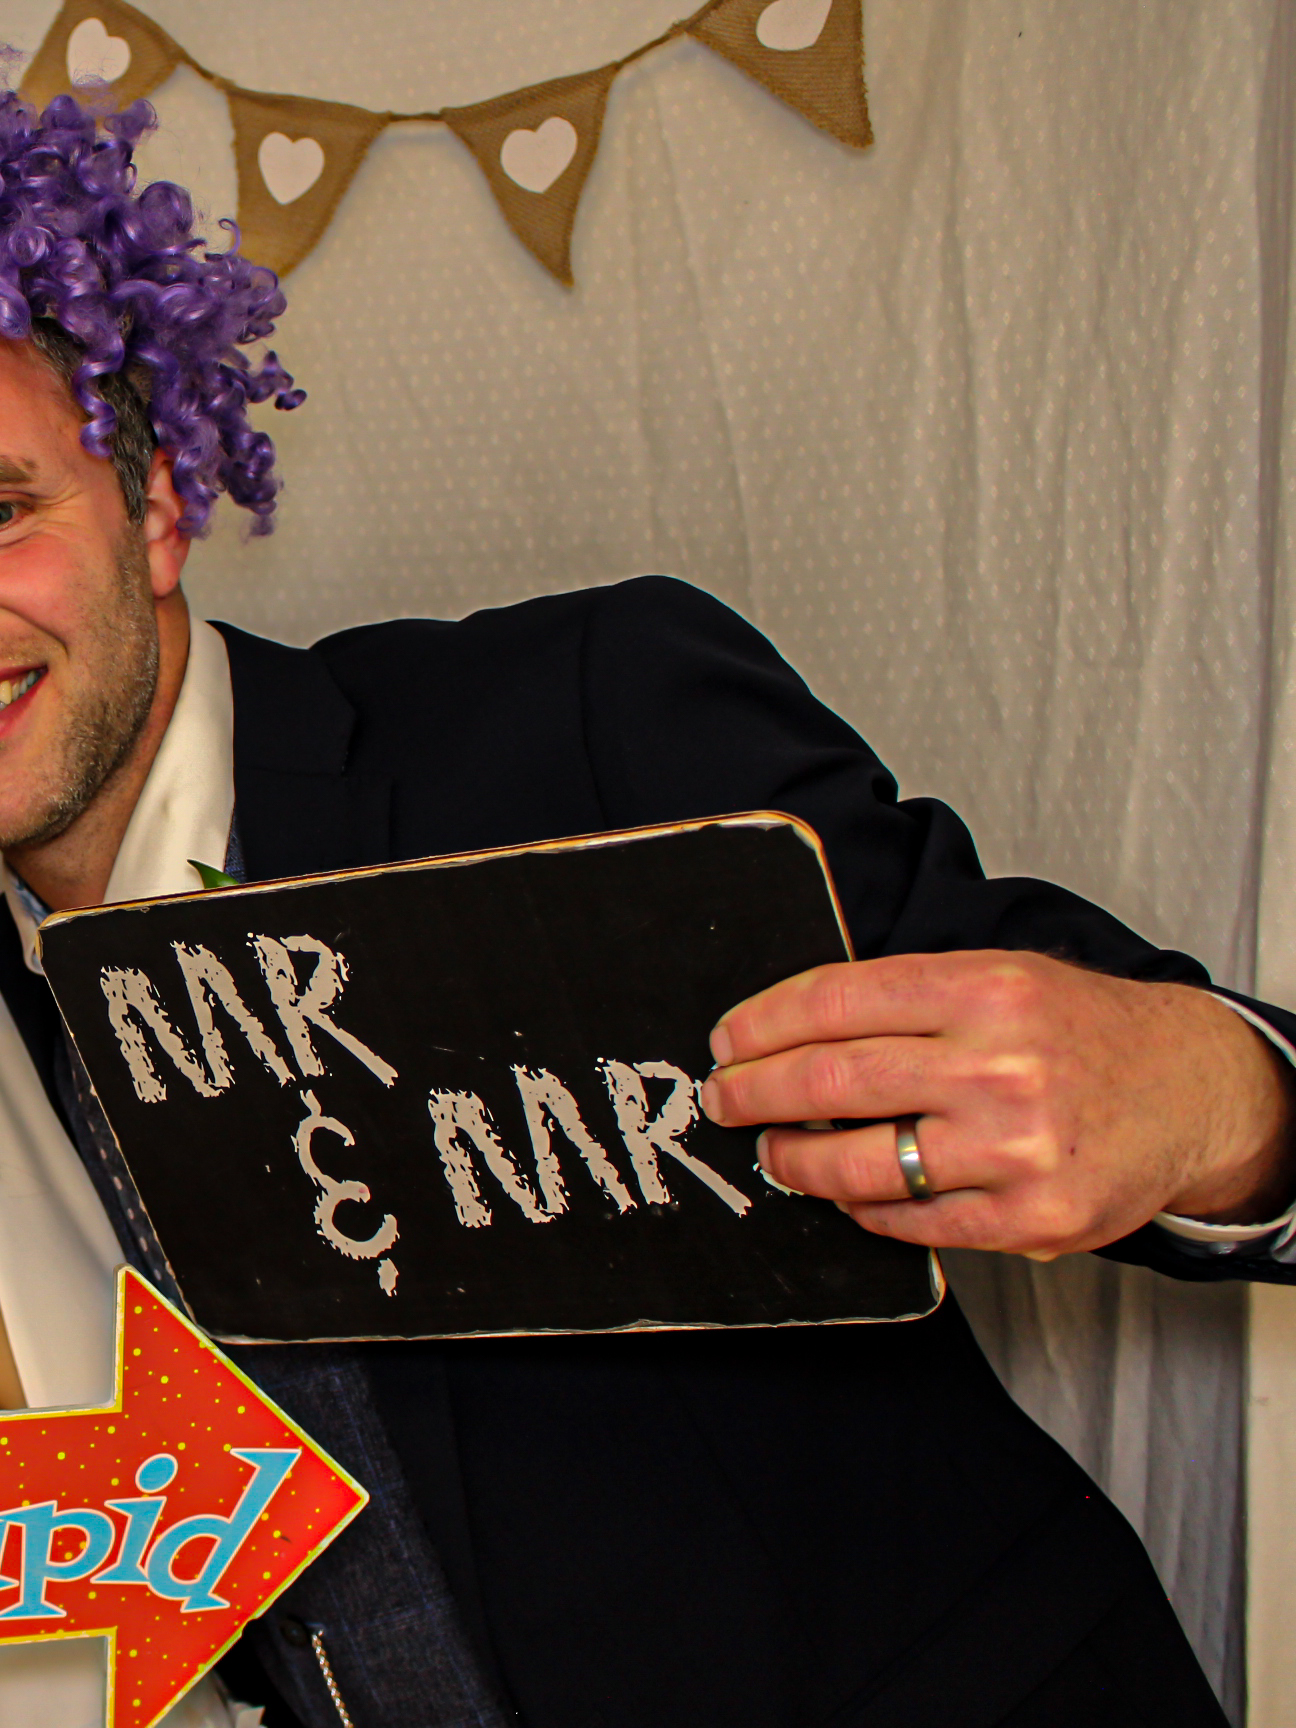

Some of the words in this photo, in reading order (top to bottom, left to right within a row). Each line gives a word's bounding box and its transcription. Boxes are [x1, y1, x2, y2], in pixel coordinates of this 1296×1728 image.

[100, 932, 398, 1104] MR
[291, 1089, 399, 1297] &
[427, 1057, 804, 1228] MR
